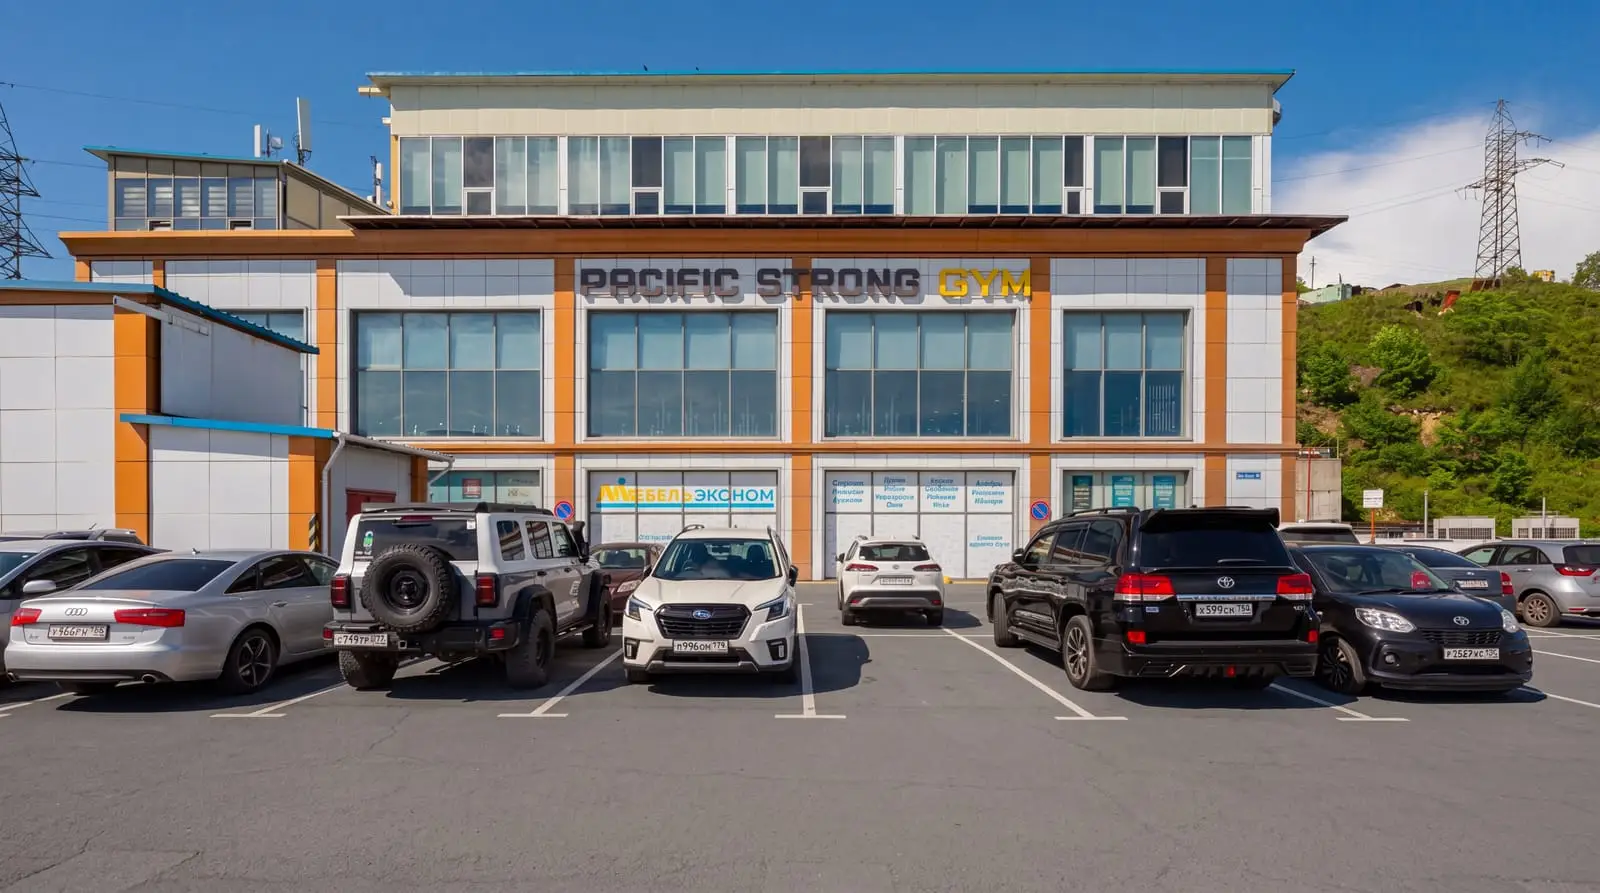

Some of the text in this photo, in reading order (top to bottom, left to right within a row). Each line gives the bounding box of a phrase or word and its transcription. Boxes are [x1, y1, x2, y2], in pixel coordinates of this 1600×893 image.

[580, 268, 1031, 297] PACIFIC STRONG GYM
